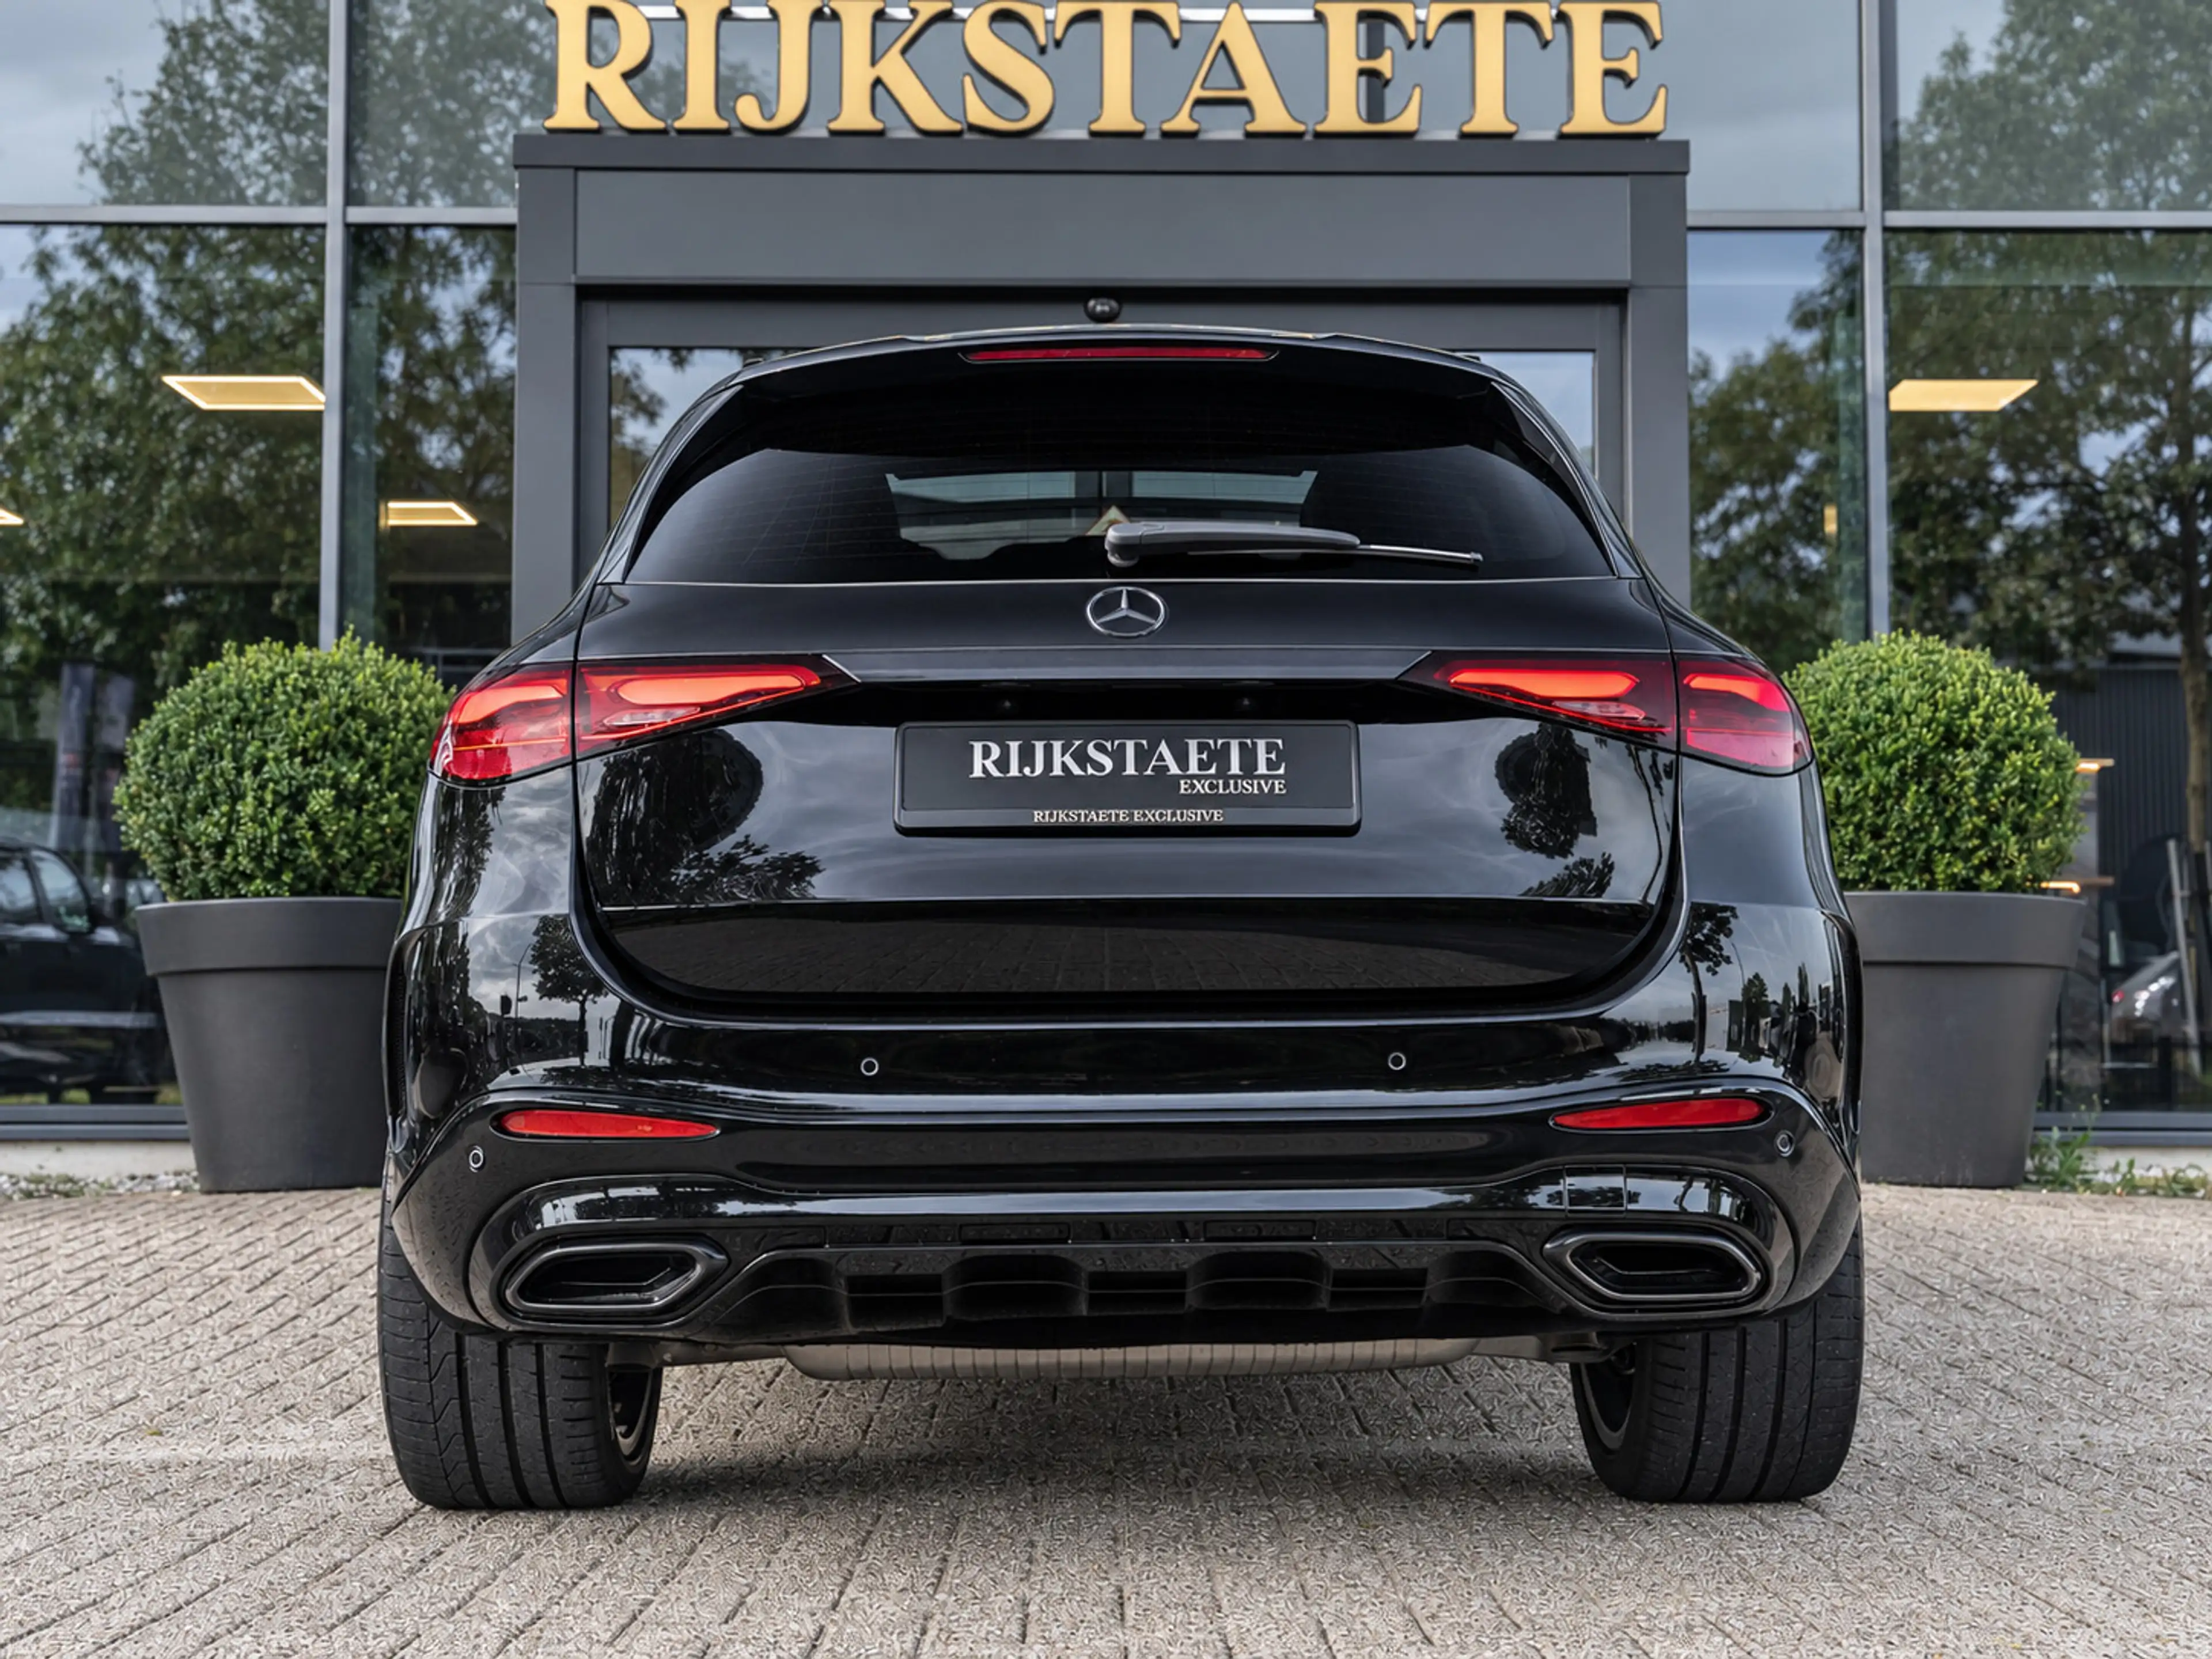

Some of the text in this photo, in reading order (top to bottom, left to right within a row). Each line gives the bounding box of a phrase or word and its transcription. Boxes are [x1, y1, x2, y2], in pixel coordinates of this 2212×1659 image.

[543, 0, 1668, 134] RIJKSTAETE
[969, 738, 1286, 778] RIJKSTAETE
[1179, 779, 1287, 794] EXCLUSIVE
[1033, 809, 1224, 823] RIJKSTAETE EXCLUSIVE
